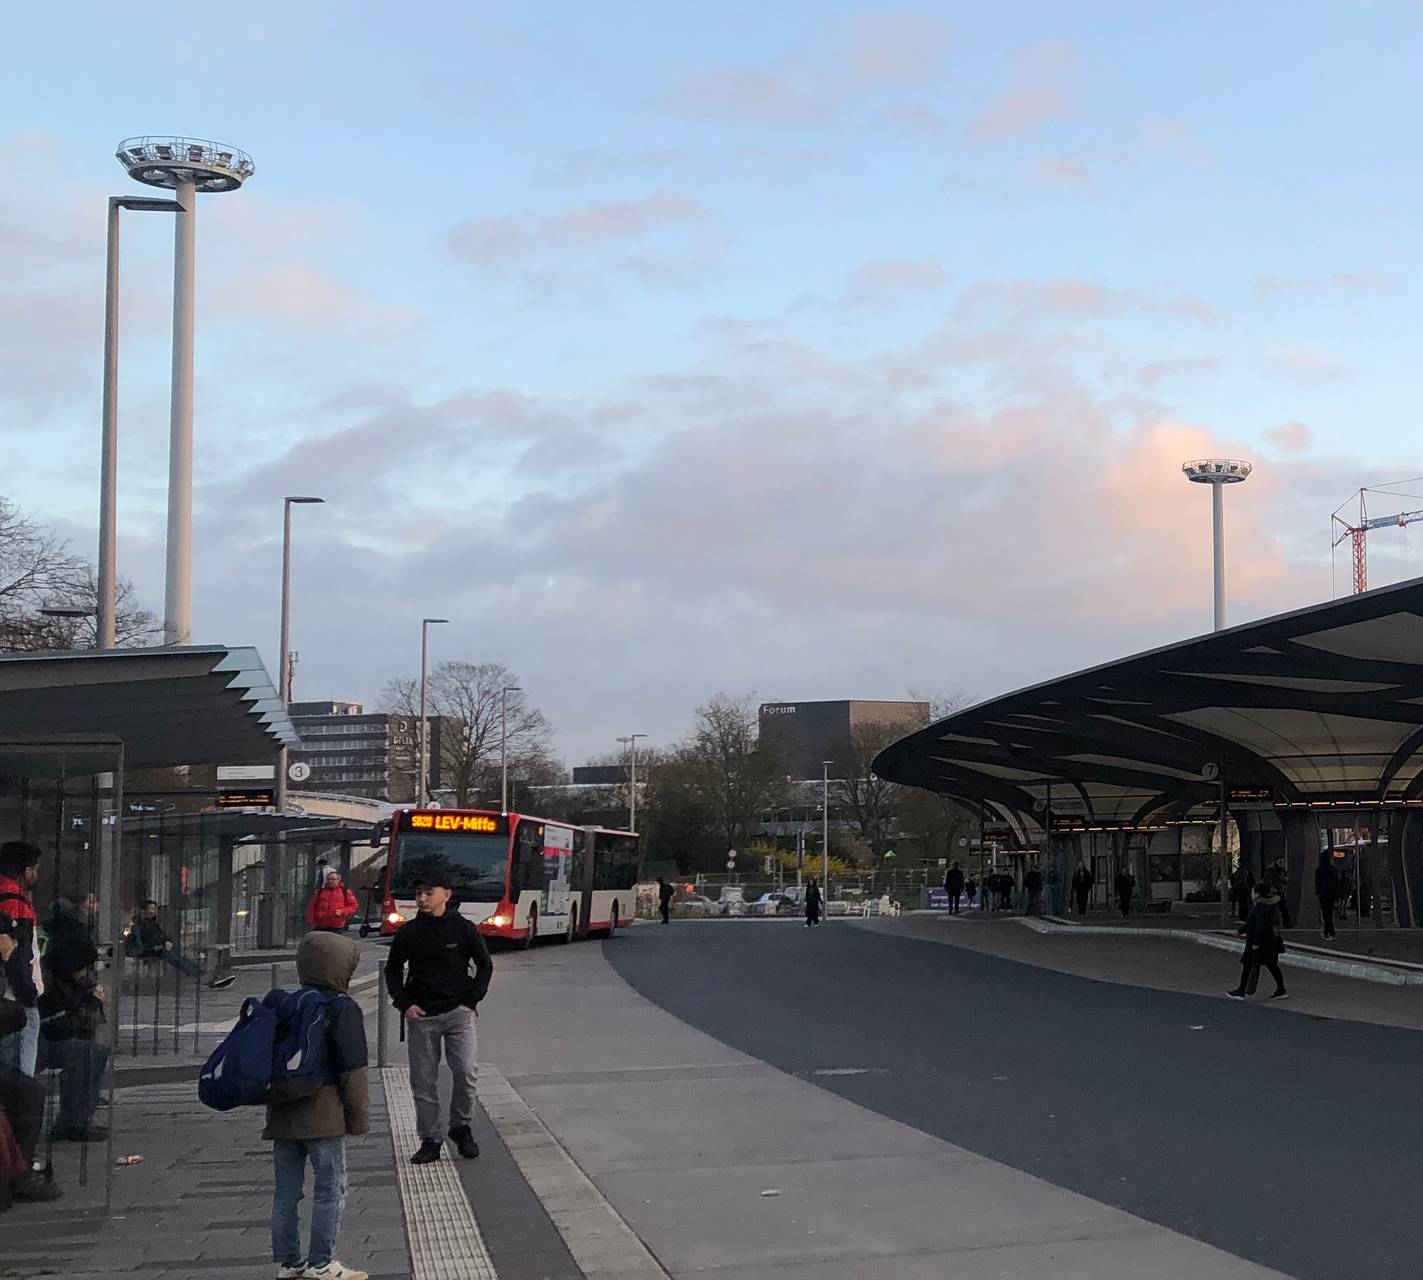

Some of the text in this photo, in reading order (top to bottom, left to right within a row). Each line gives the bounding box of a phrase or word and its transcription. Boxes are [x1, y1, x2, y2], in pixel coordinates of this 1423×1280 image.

[763, 705, 796, 715] Forum
[294, 766, 303, 778] 3
[1207, 765, 1214, 777] 7
[434, 815, 496, 831] LEV-Mitte
